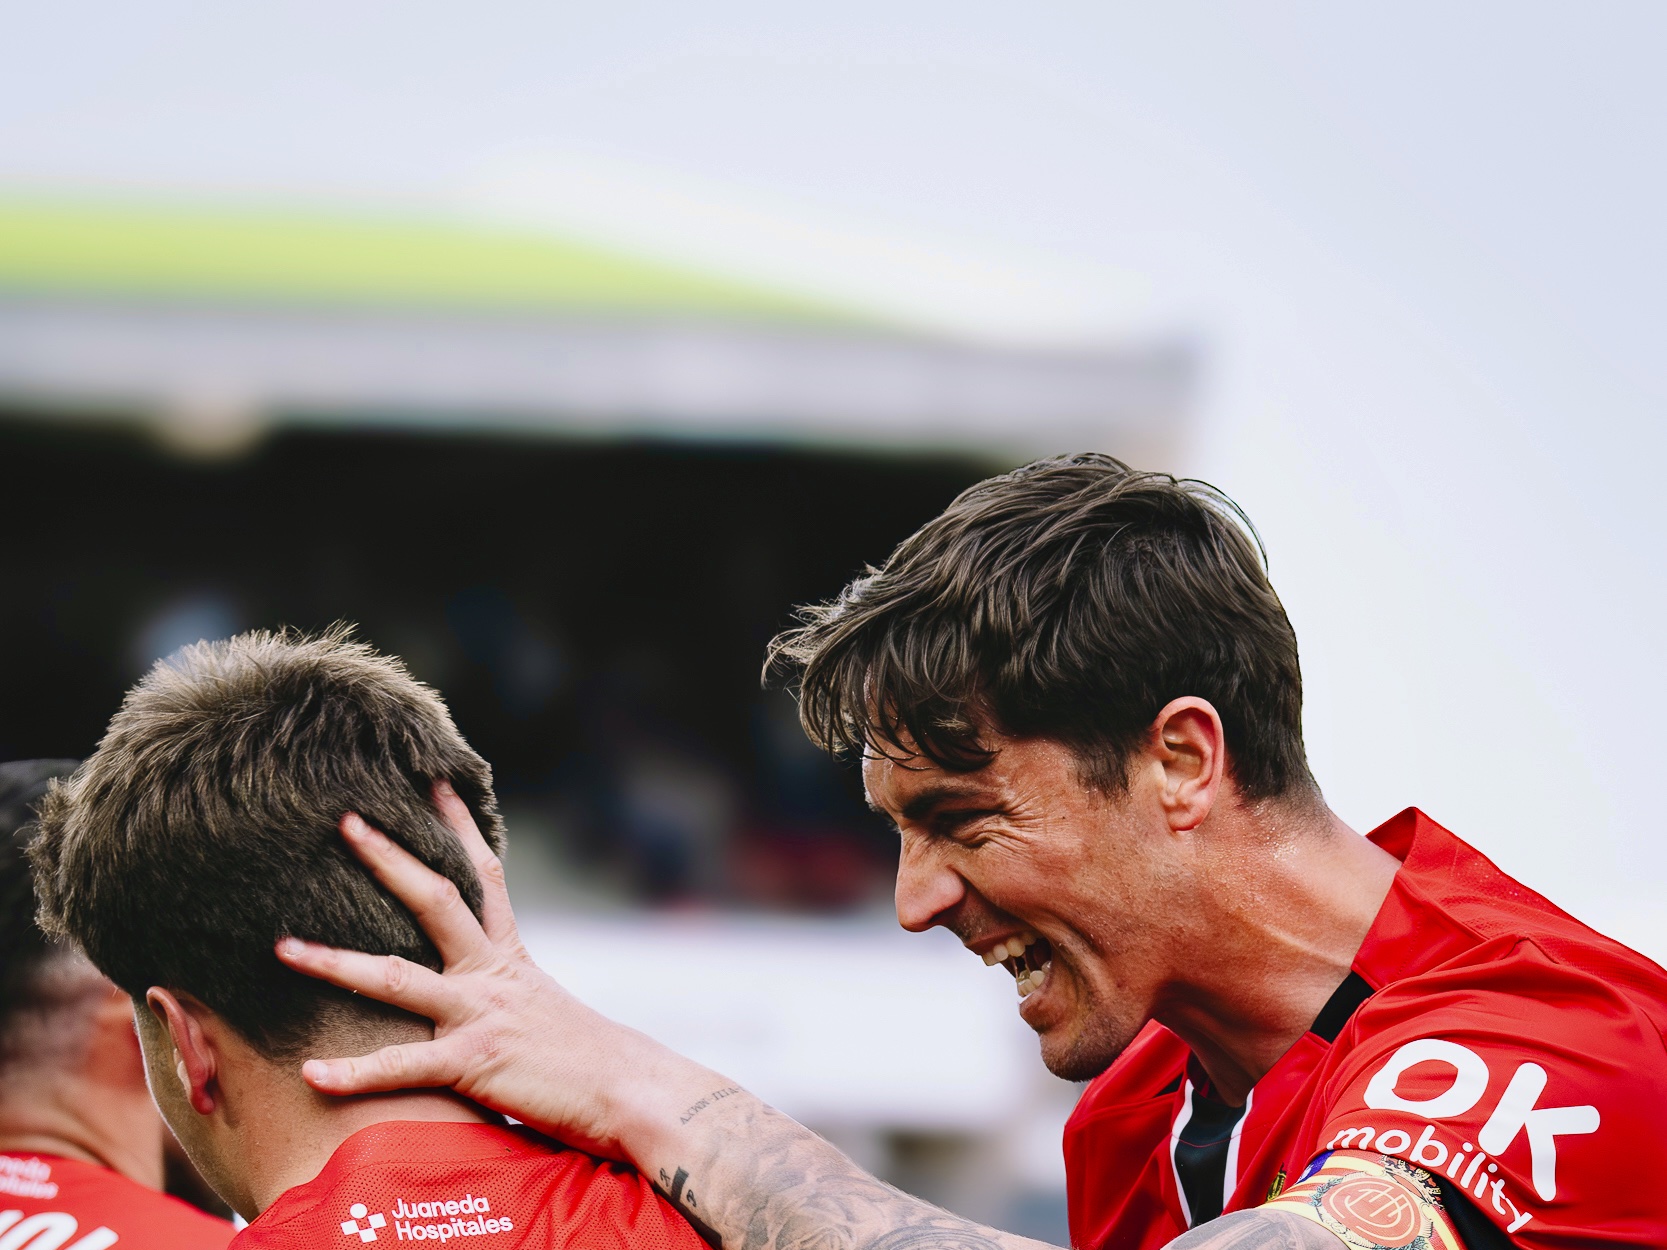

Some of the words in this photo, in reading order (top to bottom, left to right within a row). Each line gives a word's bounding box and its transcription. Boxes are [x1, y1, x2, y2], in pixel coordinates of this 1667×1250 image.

[1364, 1039, 1600, 1201] OK
[391, 1193, 491, 1220] Juaneda
[1327, 1125, 1533, 1234] mobility
[394, 1214, 514, 1243] Hospitales
